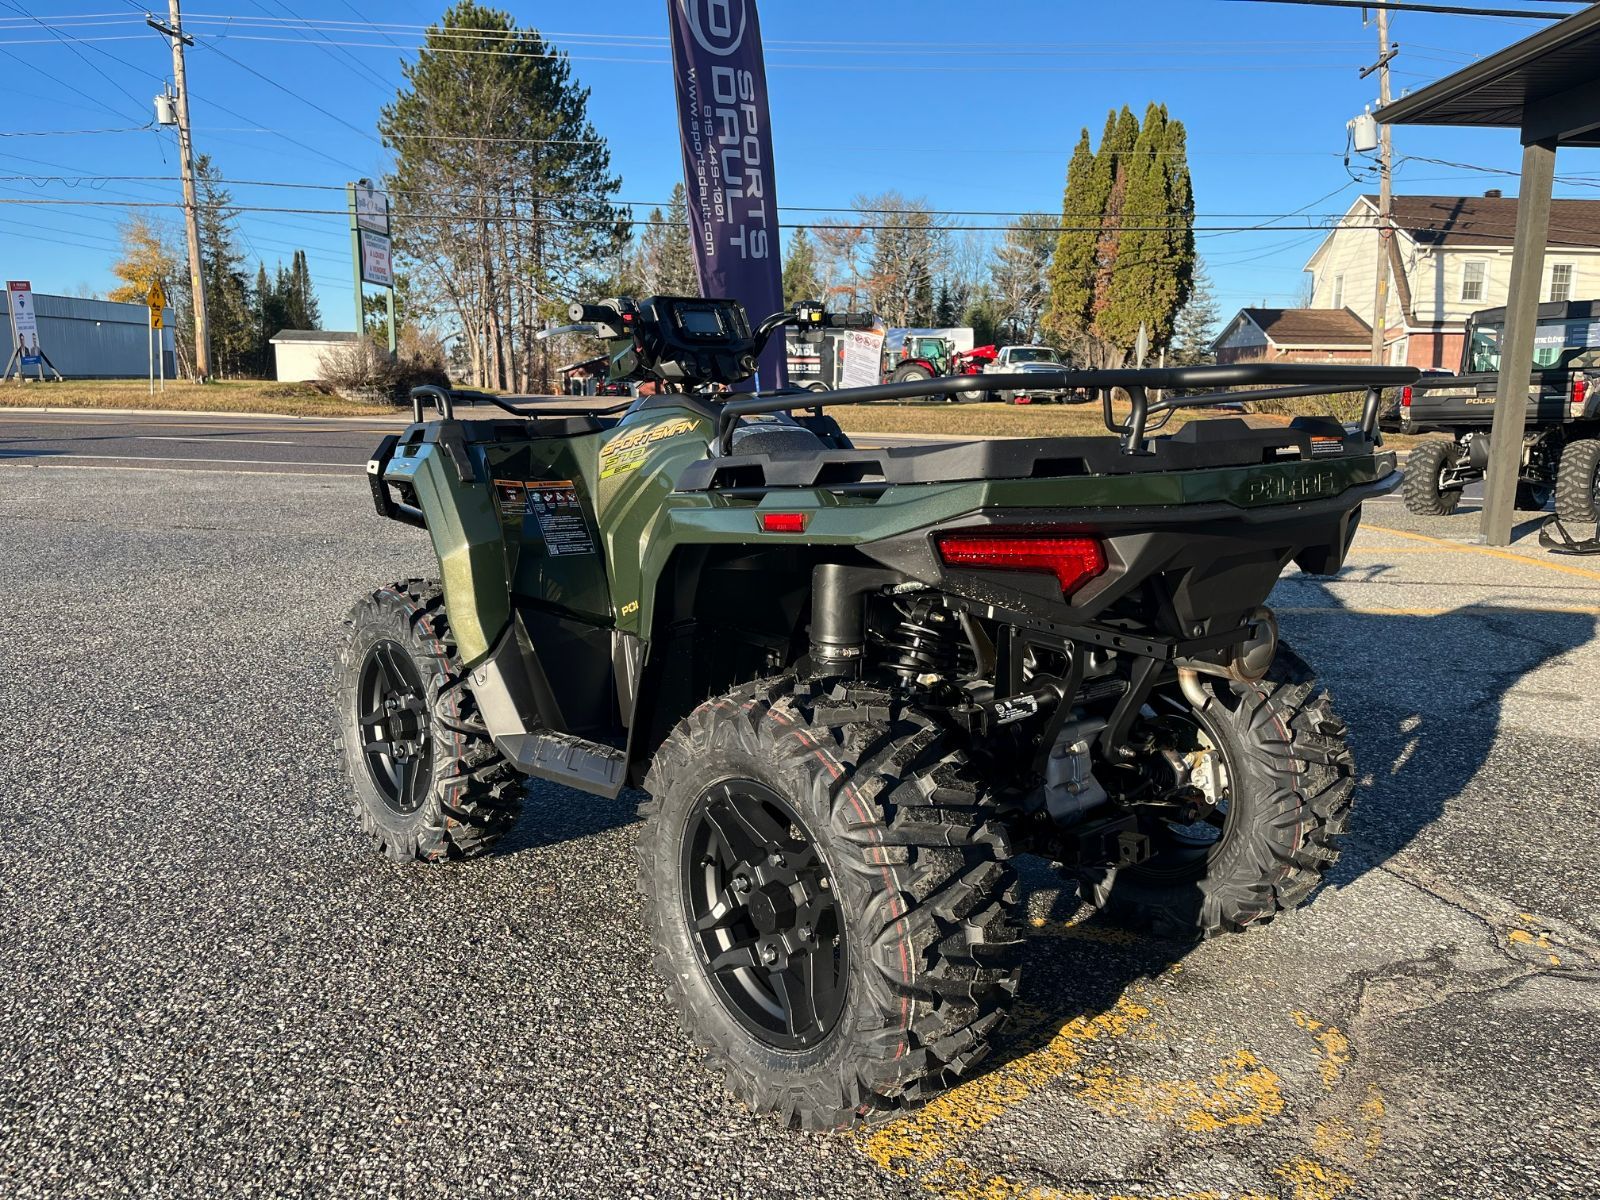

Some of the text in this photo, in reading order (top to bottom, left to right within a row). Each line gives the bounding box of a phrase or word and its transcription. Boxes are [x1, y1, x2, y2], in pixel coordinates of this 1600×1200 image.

[687, 67, 715, 256] www.sportsdault.com
[703, 105, 725, 223] 819-449-1001
[711, 65, 747, 260] DAULT
[737, 69, 769, 260] SPORTS
[601, 419, 702, 458] SPORTSMAN
[1249, 471, 1334, 501] POLARIS
